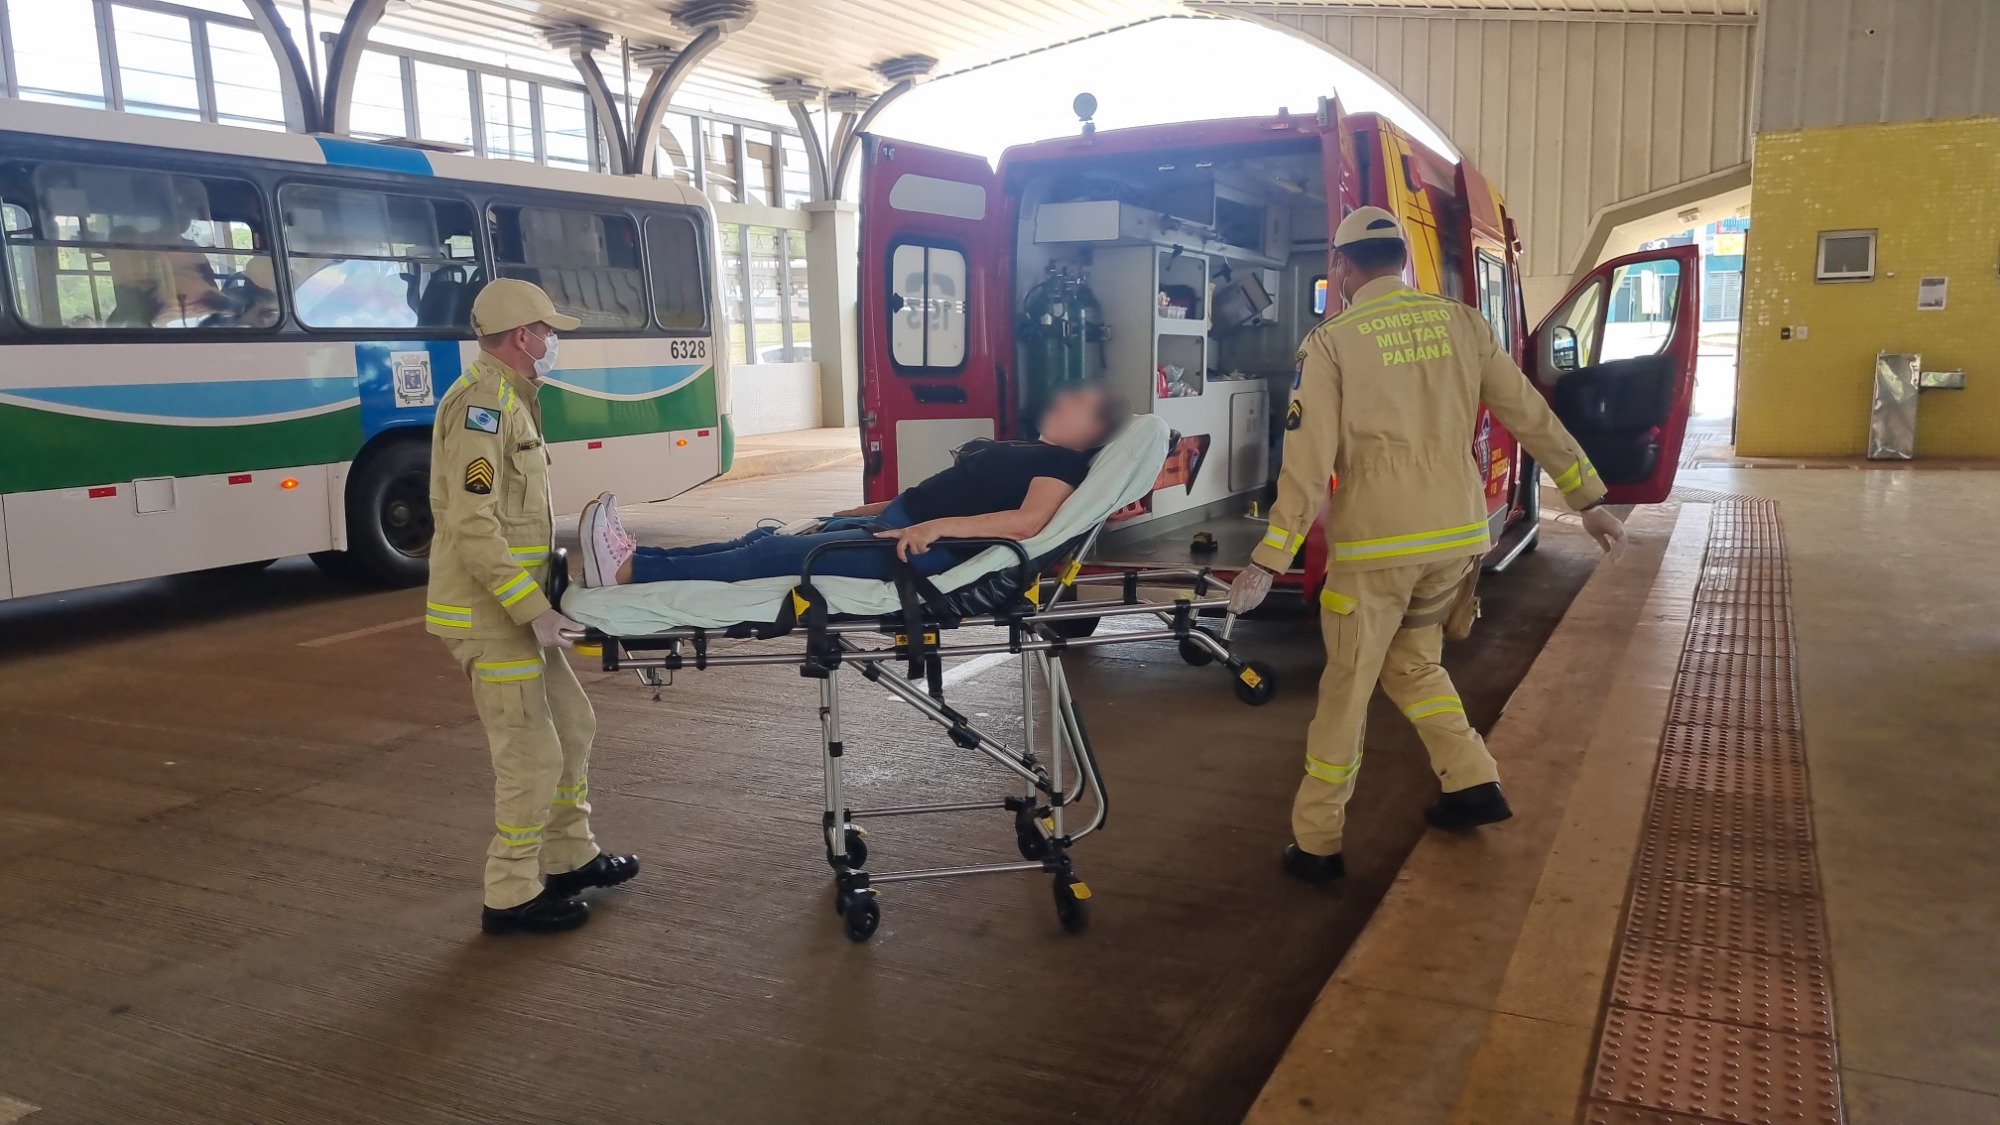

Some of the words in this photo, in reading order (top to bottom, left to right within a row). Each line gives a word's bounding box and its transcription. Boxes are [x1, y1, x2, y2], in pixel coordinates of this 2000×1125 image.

[1357, 309, 1452, 335] BOMBEIRO
[1375, 325, 1449, 347] MILITAR
[670, 340, 706, 359] 6328
[1382, 339, 1453, 366] PARANÁ
